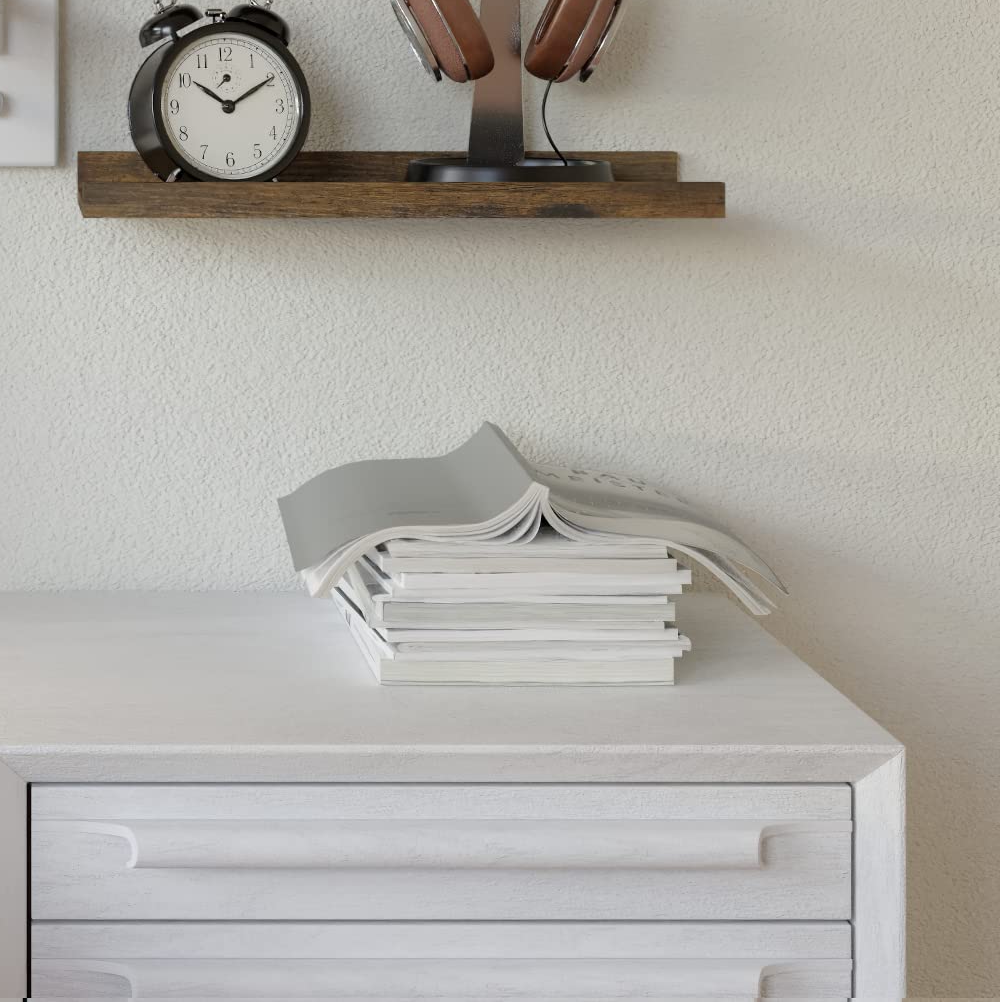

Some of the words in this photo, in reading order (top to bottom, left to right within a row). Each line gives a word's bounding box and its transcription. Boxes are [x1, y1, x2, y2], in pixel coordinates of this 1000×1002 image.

[197, 54, 208, 69] 11
[218, 47, 233, 62] 12
[249, 54, 255, 69] 1
[178, 72, 192, 88] 10
[265, 72, 275, 87] 2
[170, 99, 180, 115] 9
[275, 99, 285, 114] 3
[179, 126, 188, 142] 8
[268, 125, 277, 140] 4
[200, 144, 209, 160] 7
[253, 143, 262, 159] 5
[225, 152, 235, 167] 6
